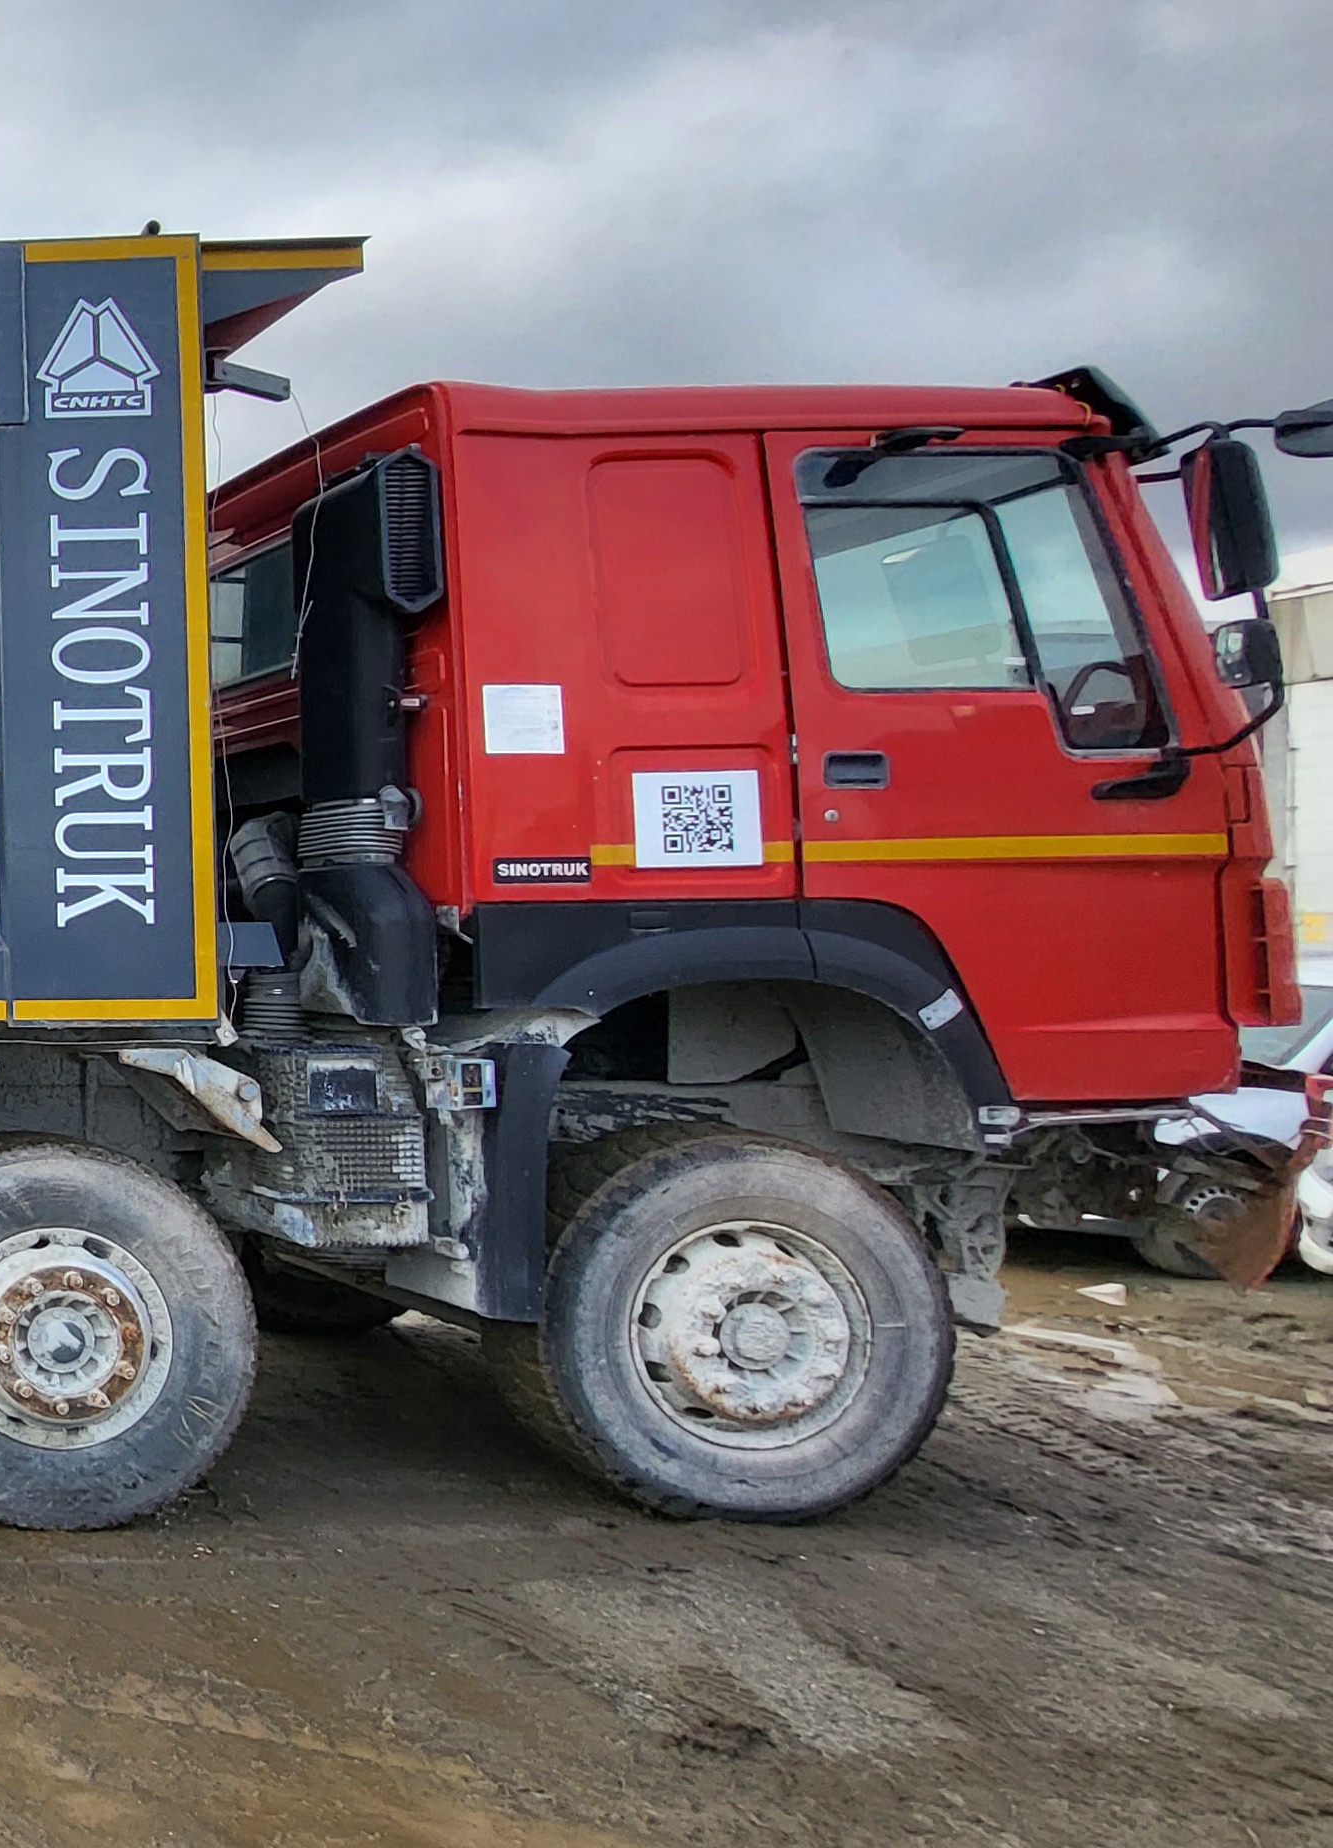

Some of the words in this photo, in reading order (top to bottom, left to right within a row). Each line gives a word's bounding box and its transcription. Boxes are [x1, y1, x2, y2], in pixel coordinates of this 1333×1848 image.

[53, 394, 143, 409] CNHTC
[46, 447, 156, 928] SINOTRUK
[496, 862, 589, 877] SINOTRUK
